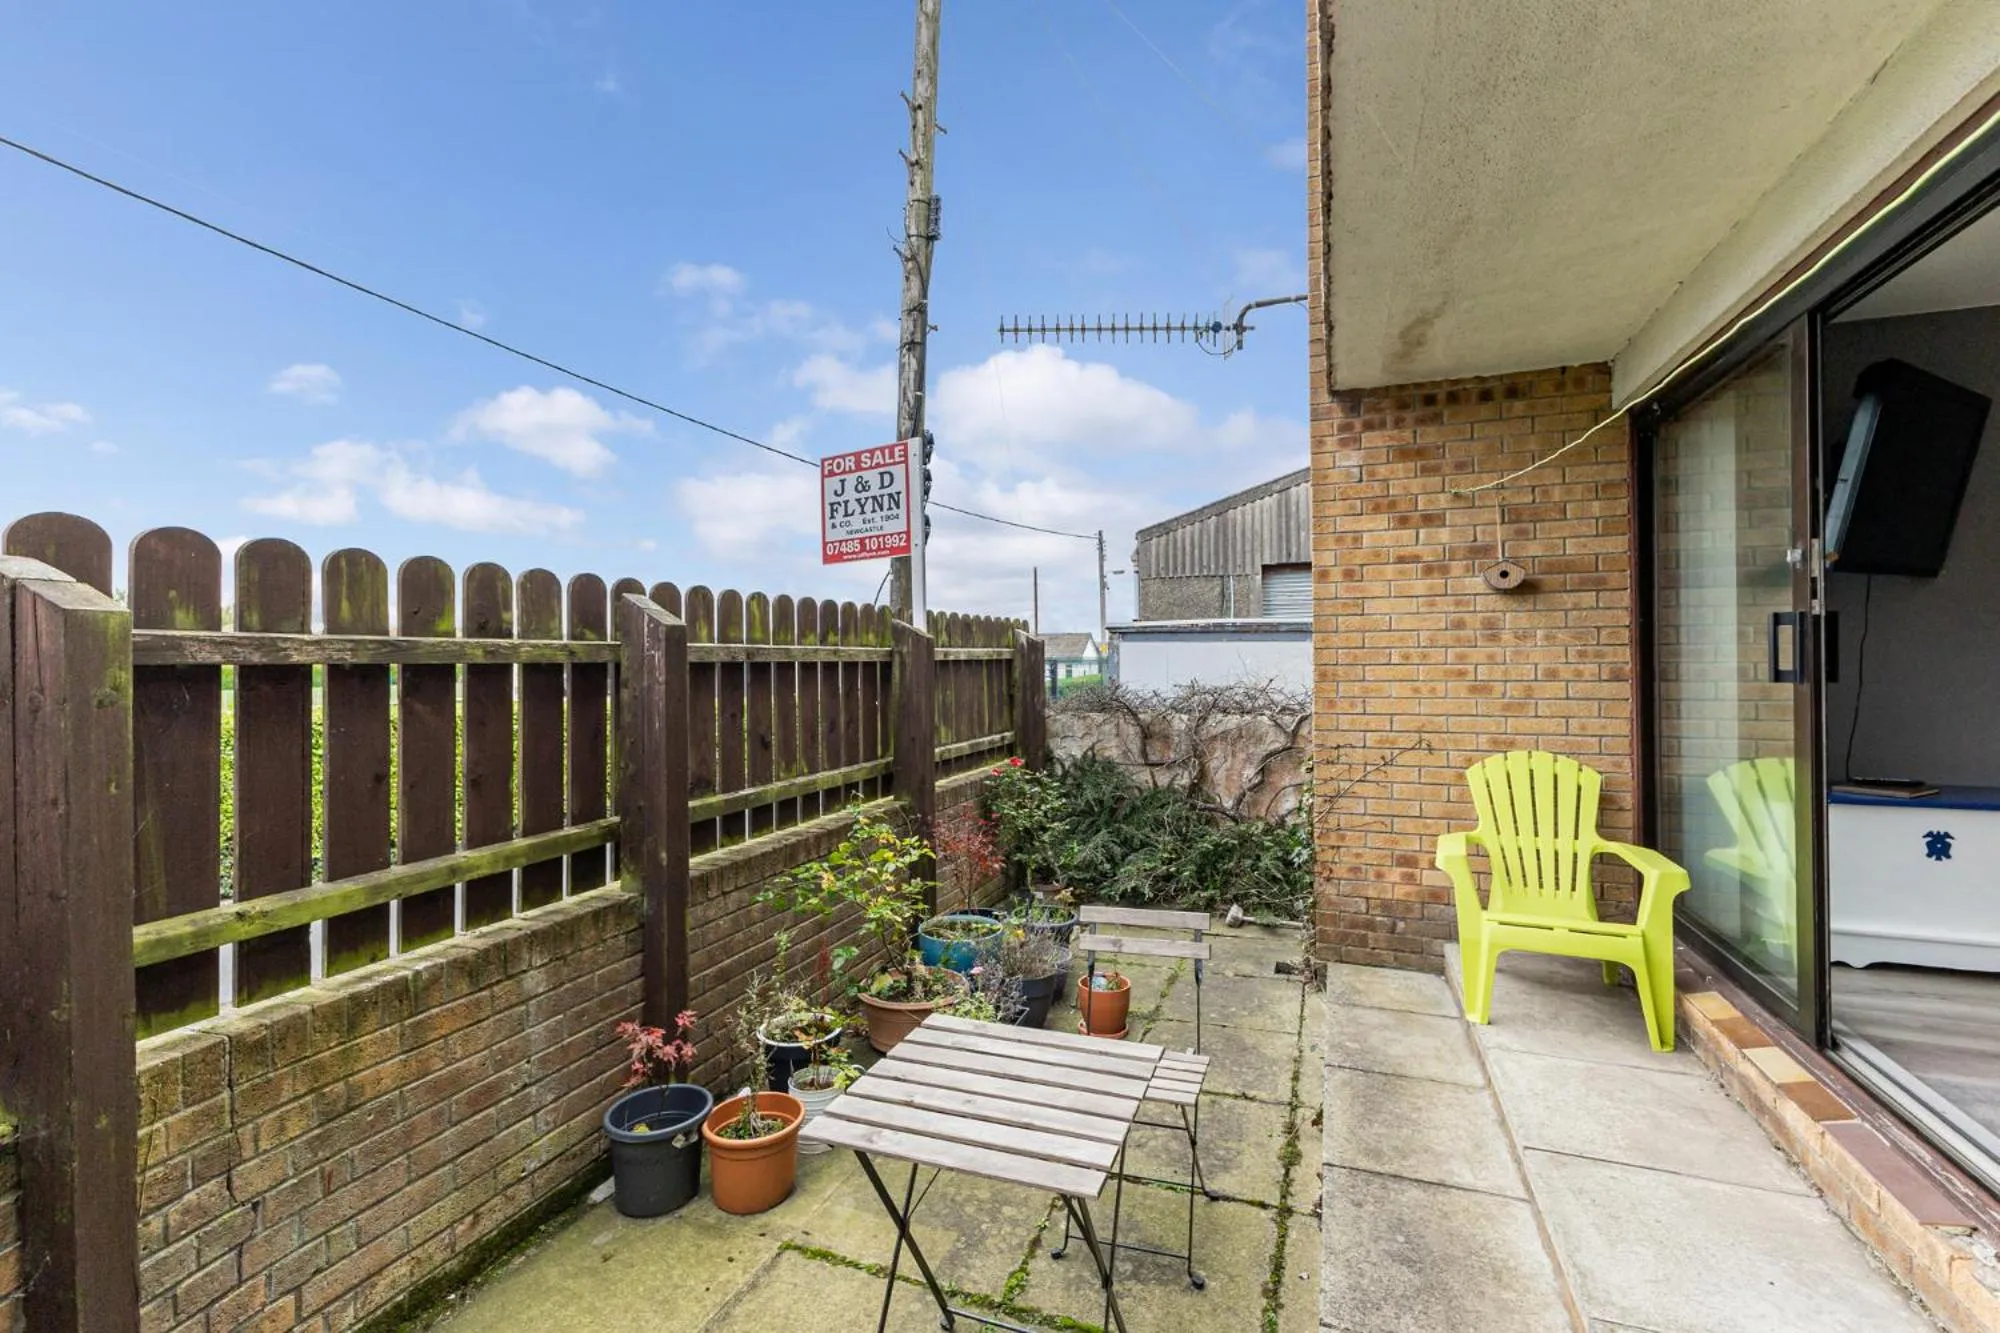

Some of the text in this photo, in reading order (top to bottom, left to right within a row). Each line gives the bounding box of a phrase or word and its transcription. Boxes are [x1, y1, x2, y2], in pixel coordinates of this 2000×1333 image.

[823, 445, 906, 475] FOR SALE
[834, 470, 895, 497] J & D
[828, 491, 902, 520] FLYNN
[846, 525, 884, 535] NEWCASTLE
[826, 540, 861, 555] 07485
[864, 533, 907, 550] 101992
